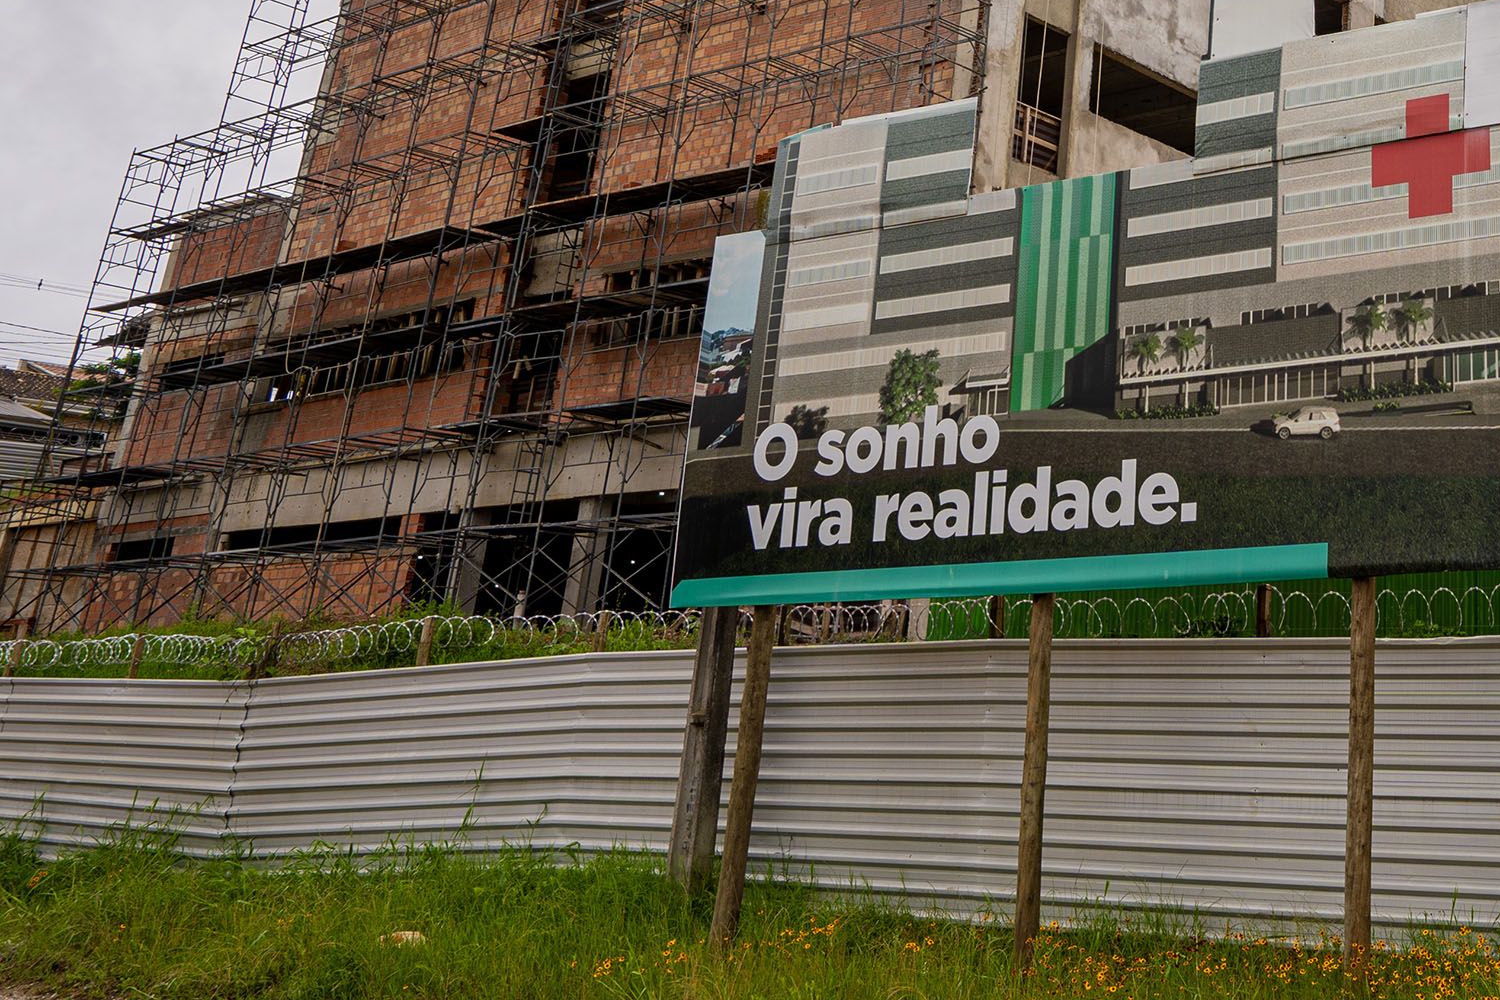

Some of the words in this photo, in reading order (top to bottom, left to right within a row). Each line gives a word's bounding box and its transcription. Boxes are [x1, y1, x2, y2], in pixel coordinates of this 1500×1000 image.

[753, 422, 798, 482] O
[814, 405, 1001, 477] sonho
[746, 487, 854, 551] vira
[872, 459, 1198, 543] realidade.
